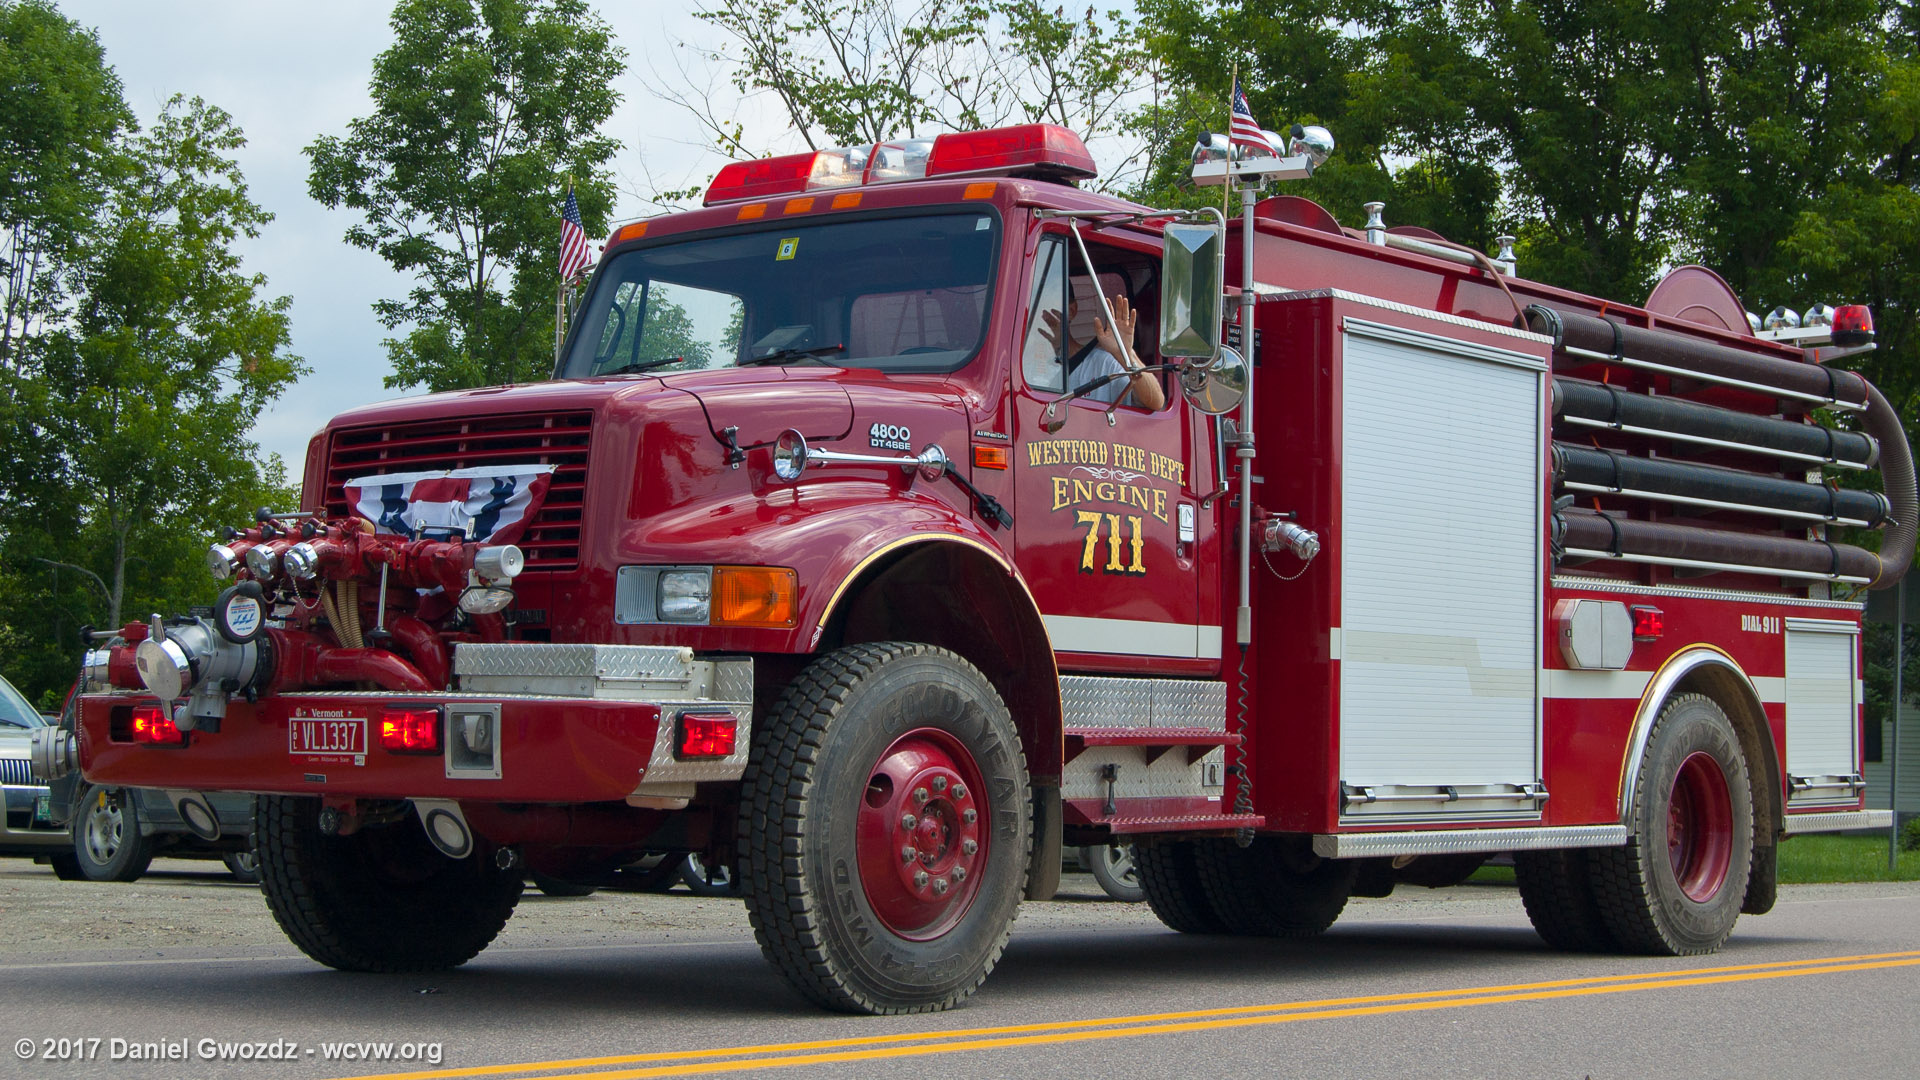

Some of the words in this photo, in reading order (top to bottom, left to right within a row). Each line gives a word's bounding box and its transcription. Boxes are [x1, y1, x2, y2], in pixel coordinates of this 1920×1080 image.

[870, 423, 911, 441] 4800
[886, 440, 911, 450] 466E
[1027, 439, 1108, 467] WESTFORD
[1113, 443, 1146, 473] FIRE
[1150, 452, 1186, 487] DEPT.
[1052, 476, 1168, 524] ENGINE
[1075, 510, 1147, 575] 711
[1741, 614, 1762, 632] DIAL
[1762, 616, 1779, 634] 911
[312, 708, 344, 718] Vermont
[302, 722, 357, 750] VL1337
